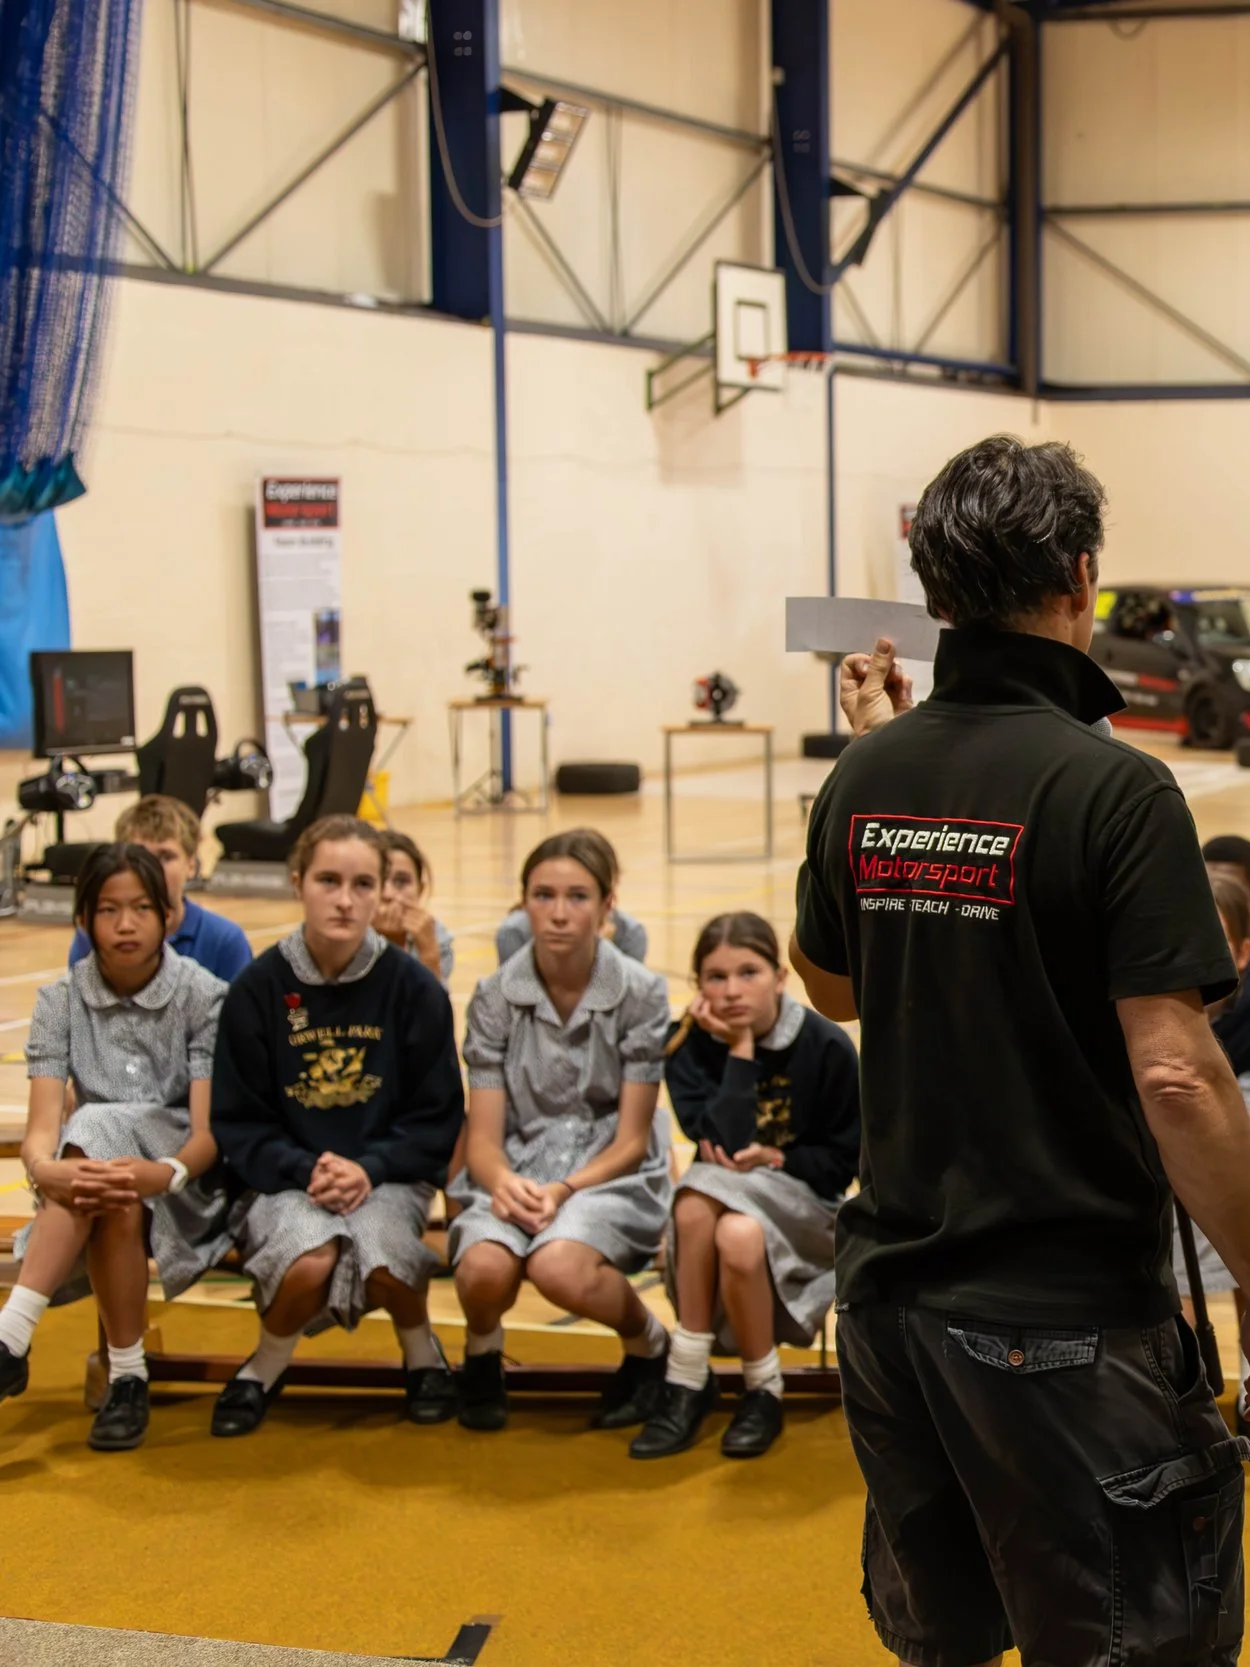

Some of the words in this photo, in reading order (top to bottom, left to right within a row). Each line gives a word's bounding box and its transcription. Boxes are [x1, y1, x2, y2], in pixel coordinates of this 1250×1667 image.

[861, 822, 1010, 856] Experience
[859, 853, 999, 889] Motorsport
[860, 898, 906, 911] INSPIRE
